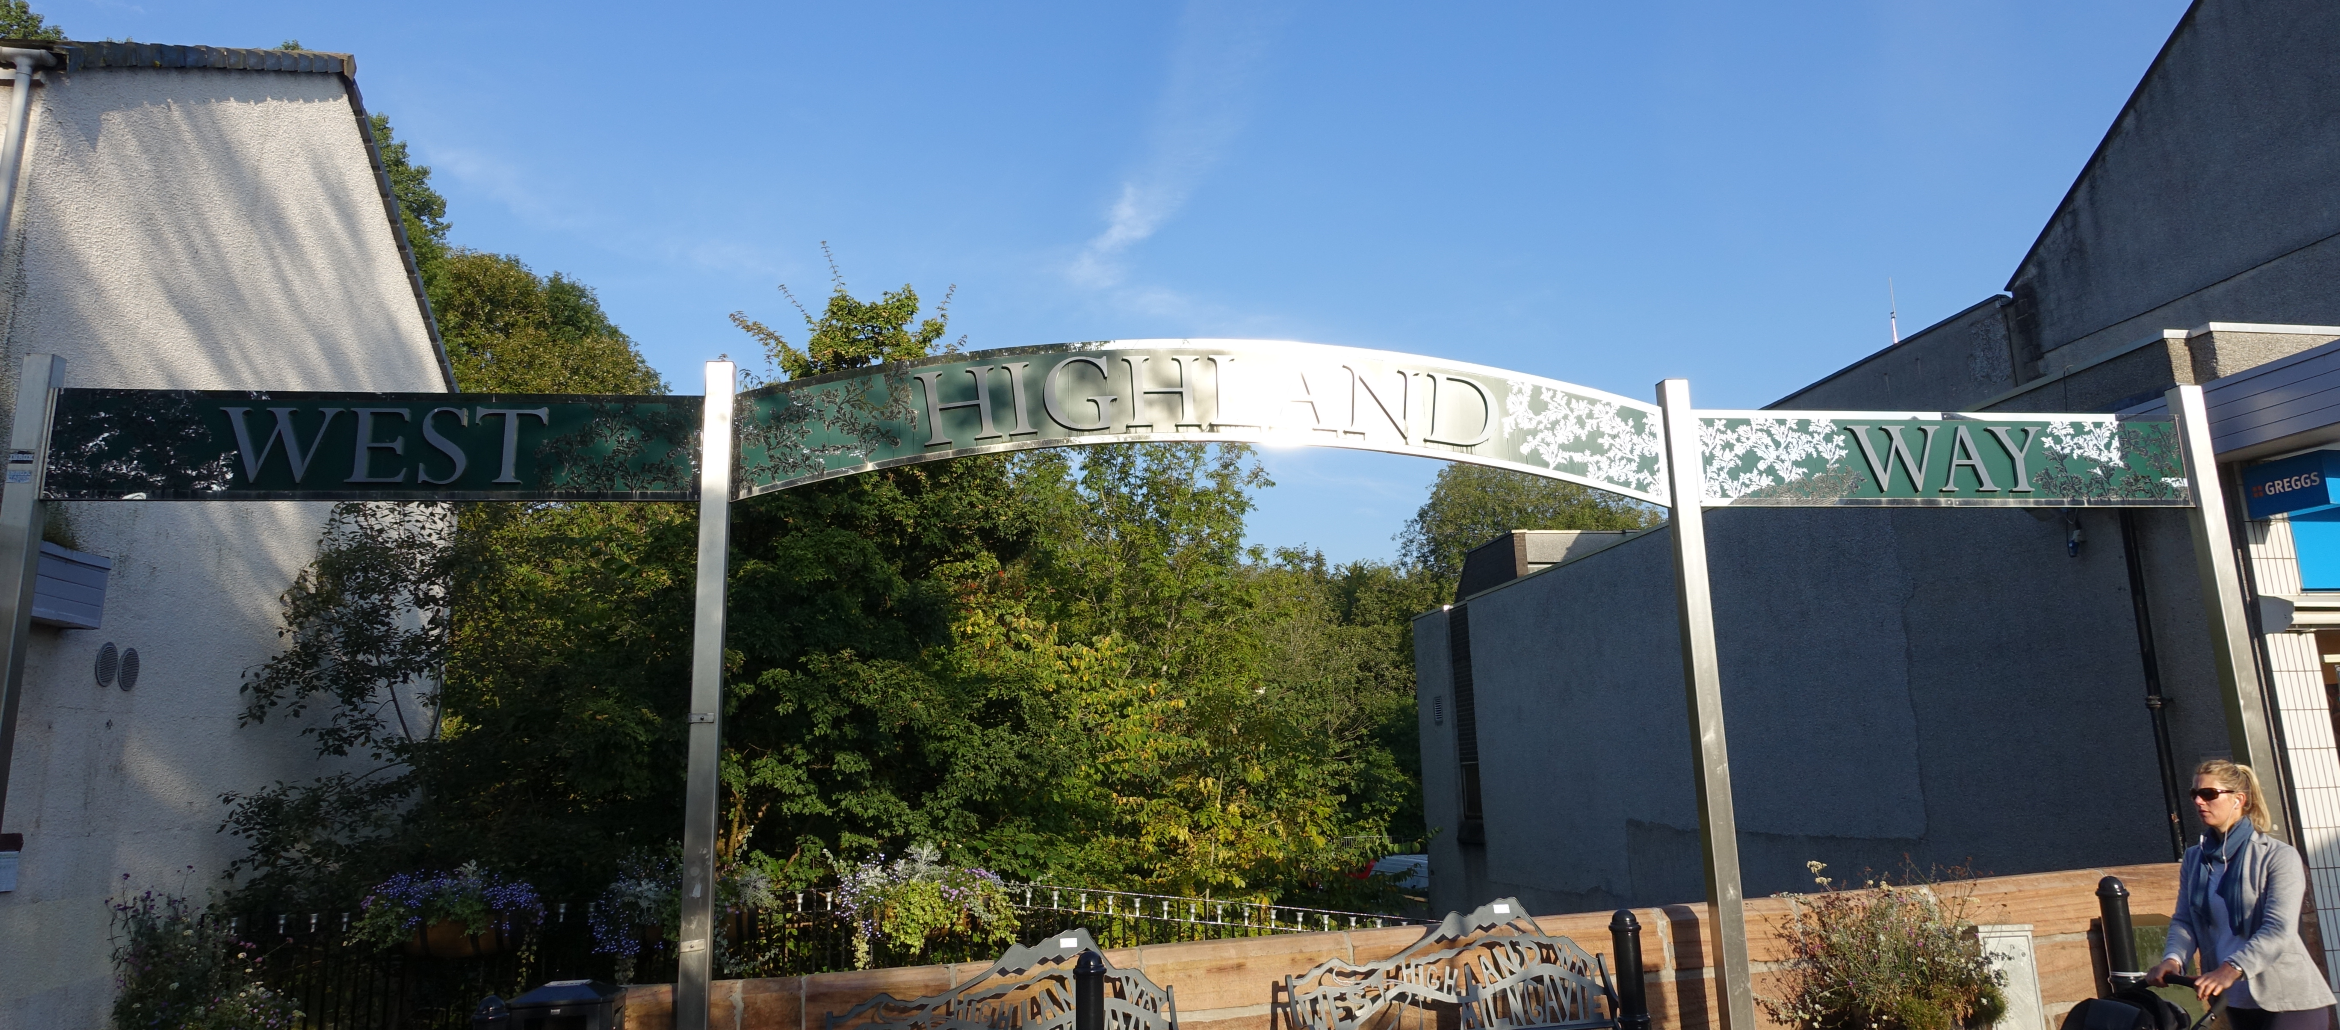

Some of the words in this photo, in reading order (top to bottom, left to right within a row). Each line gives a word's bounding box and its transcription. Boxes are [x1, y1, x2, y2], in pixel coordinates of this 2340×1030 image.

[219, 405, 550, 486] WEST
[913, 354, 1500, 448] HIGHLAND
[1843, 425, 2042, 494] WAY
[2264, 471, 2321, 497] GREGGS
[1400, 938, 1541, 998] HIGHLAND
[1553, 940, 1599, 983] WAY
[953, 976, 1077, 1030] HIGHLAN
